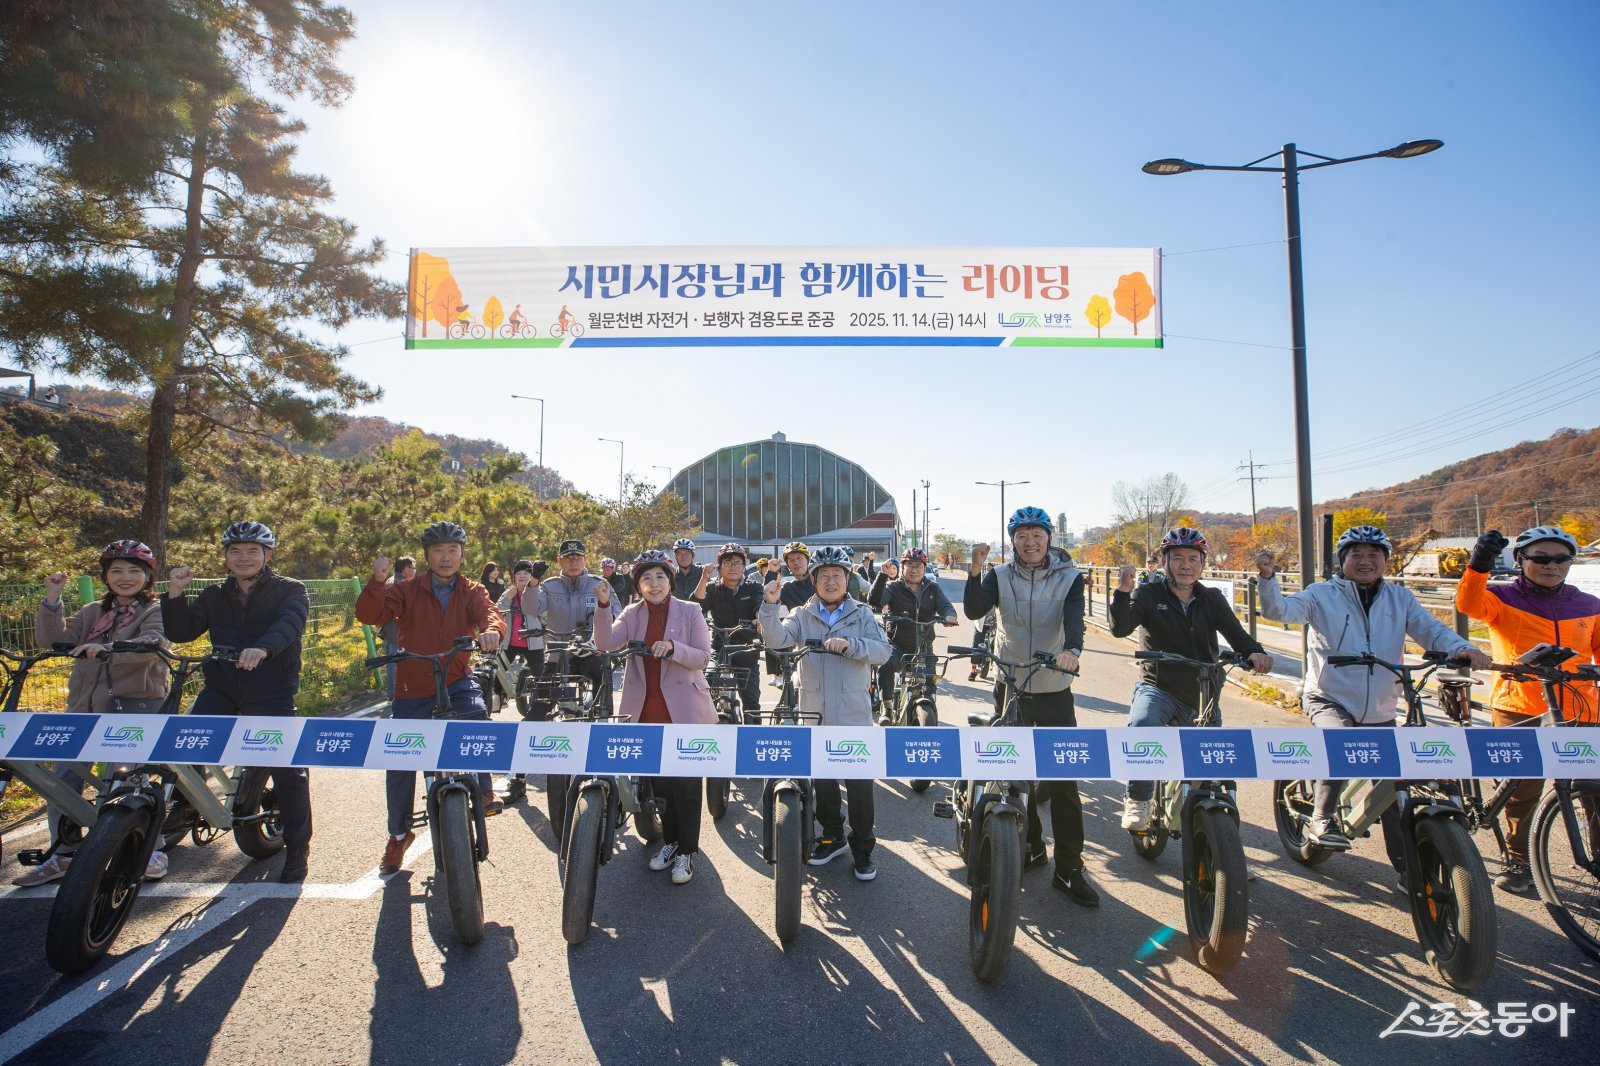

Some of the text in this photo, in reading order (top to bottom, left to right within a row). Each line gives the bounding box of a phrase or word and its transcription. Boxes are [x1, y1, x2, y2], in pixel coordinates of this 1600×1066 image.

[558, 262, 1070, 300] 시민시장님과 함께하는 라이딩
[588, 312, 643, 329] 월문천변
[646, 311, 688, 329] 자전거
[702, 311, 745, 328] 보행자
[748, 311, 804, 328] 겸용도로
[807, 311, 836, 328] 준공
[849, 312, 888, 327] 2025.
[959, 312, 986, 329] 14시
[1044, 313, 1072, 324] 남양주
[34, 733, 72, 746] 남양주
[175, 736, 210, 749] 남양주
[316, 739, 351, 752] 남양주
[460, 742, 495, 755] 남양주
[607, 746, 643, 759] 남양주
[756, 748, 792, 761] 남양주
[905, 750, 942, 762] 남양주
[1054, 750, 1090, 763] 남양주
[1200, 750, 1237, 764] 남양주
[1345, 750, 1381, 763] 남양주
[1488, 750, 1524, 763] 남양주
